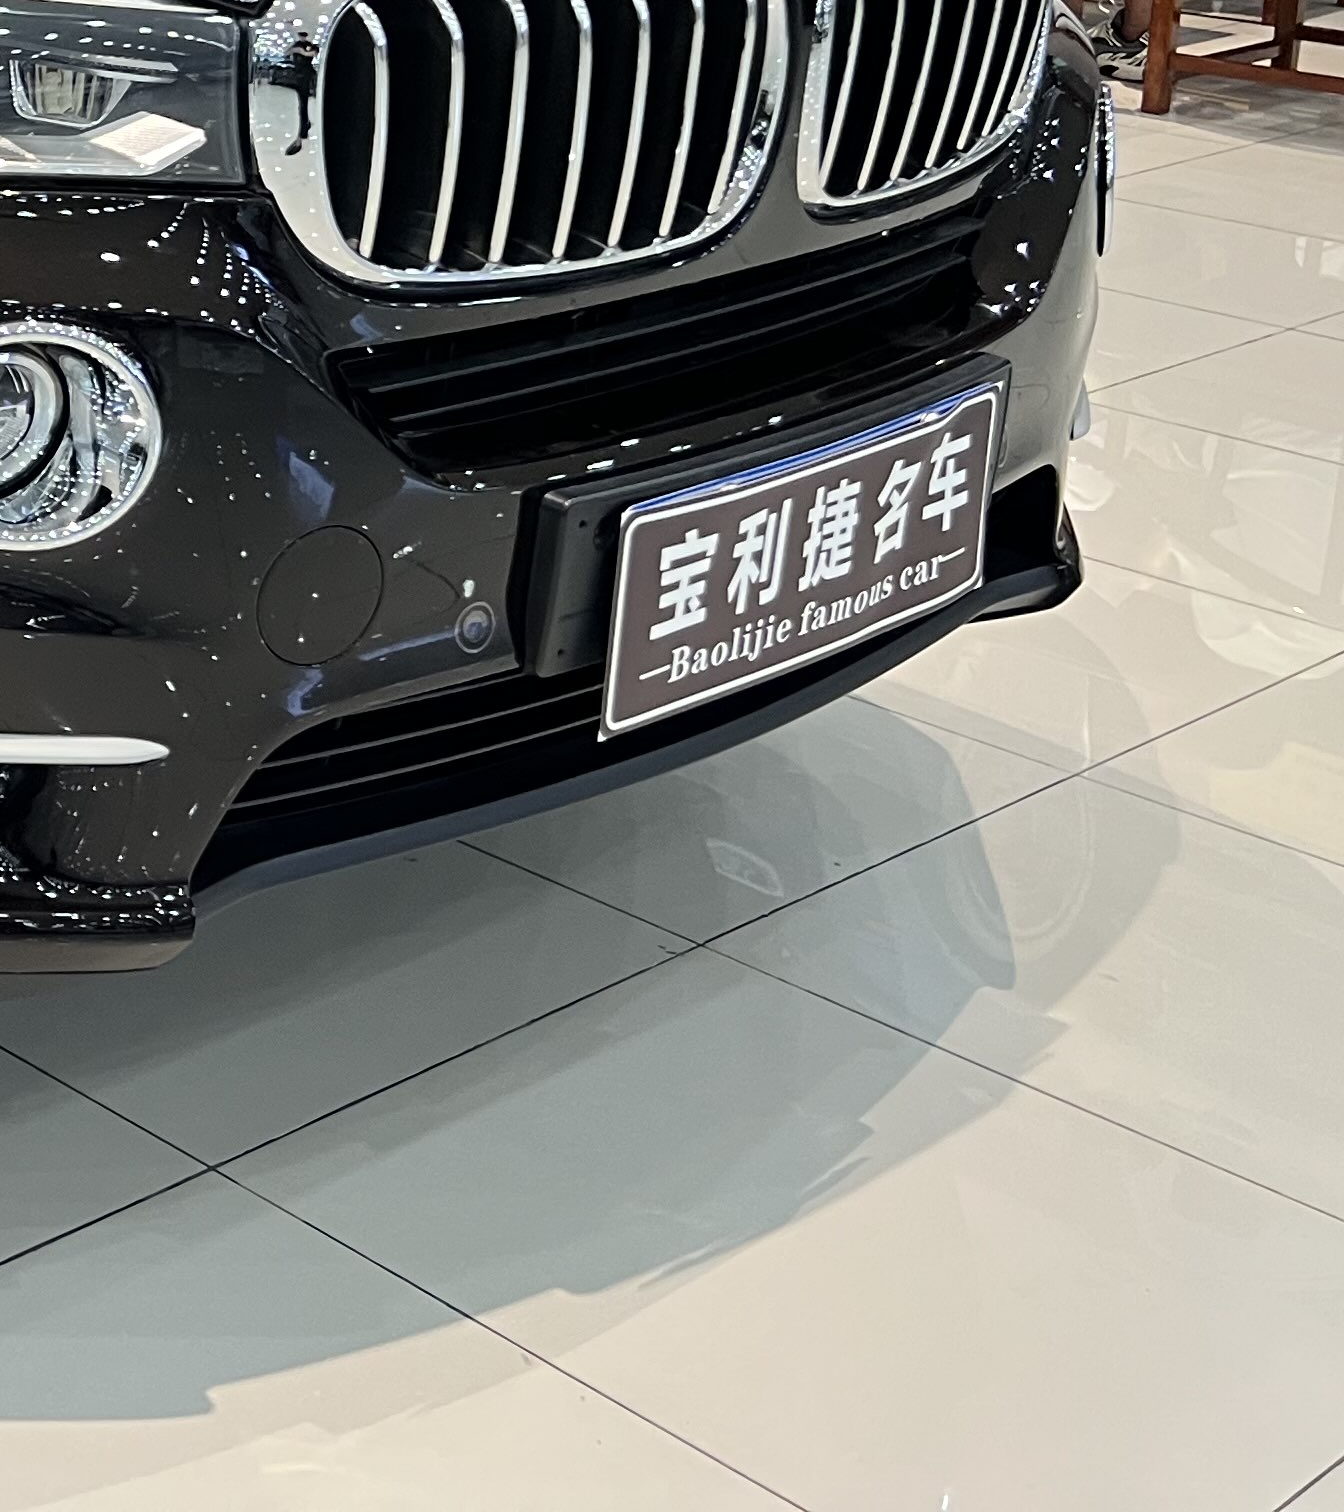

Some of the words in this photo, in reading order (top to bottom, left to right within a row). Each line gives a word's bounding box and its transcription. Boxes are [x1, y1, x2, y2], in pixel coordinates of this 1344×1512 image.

[648, 431, 973, 641] 宝利捷名车
[798, 571, 894, 637] famous
